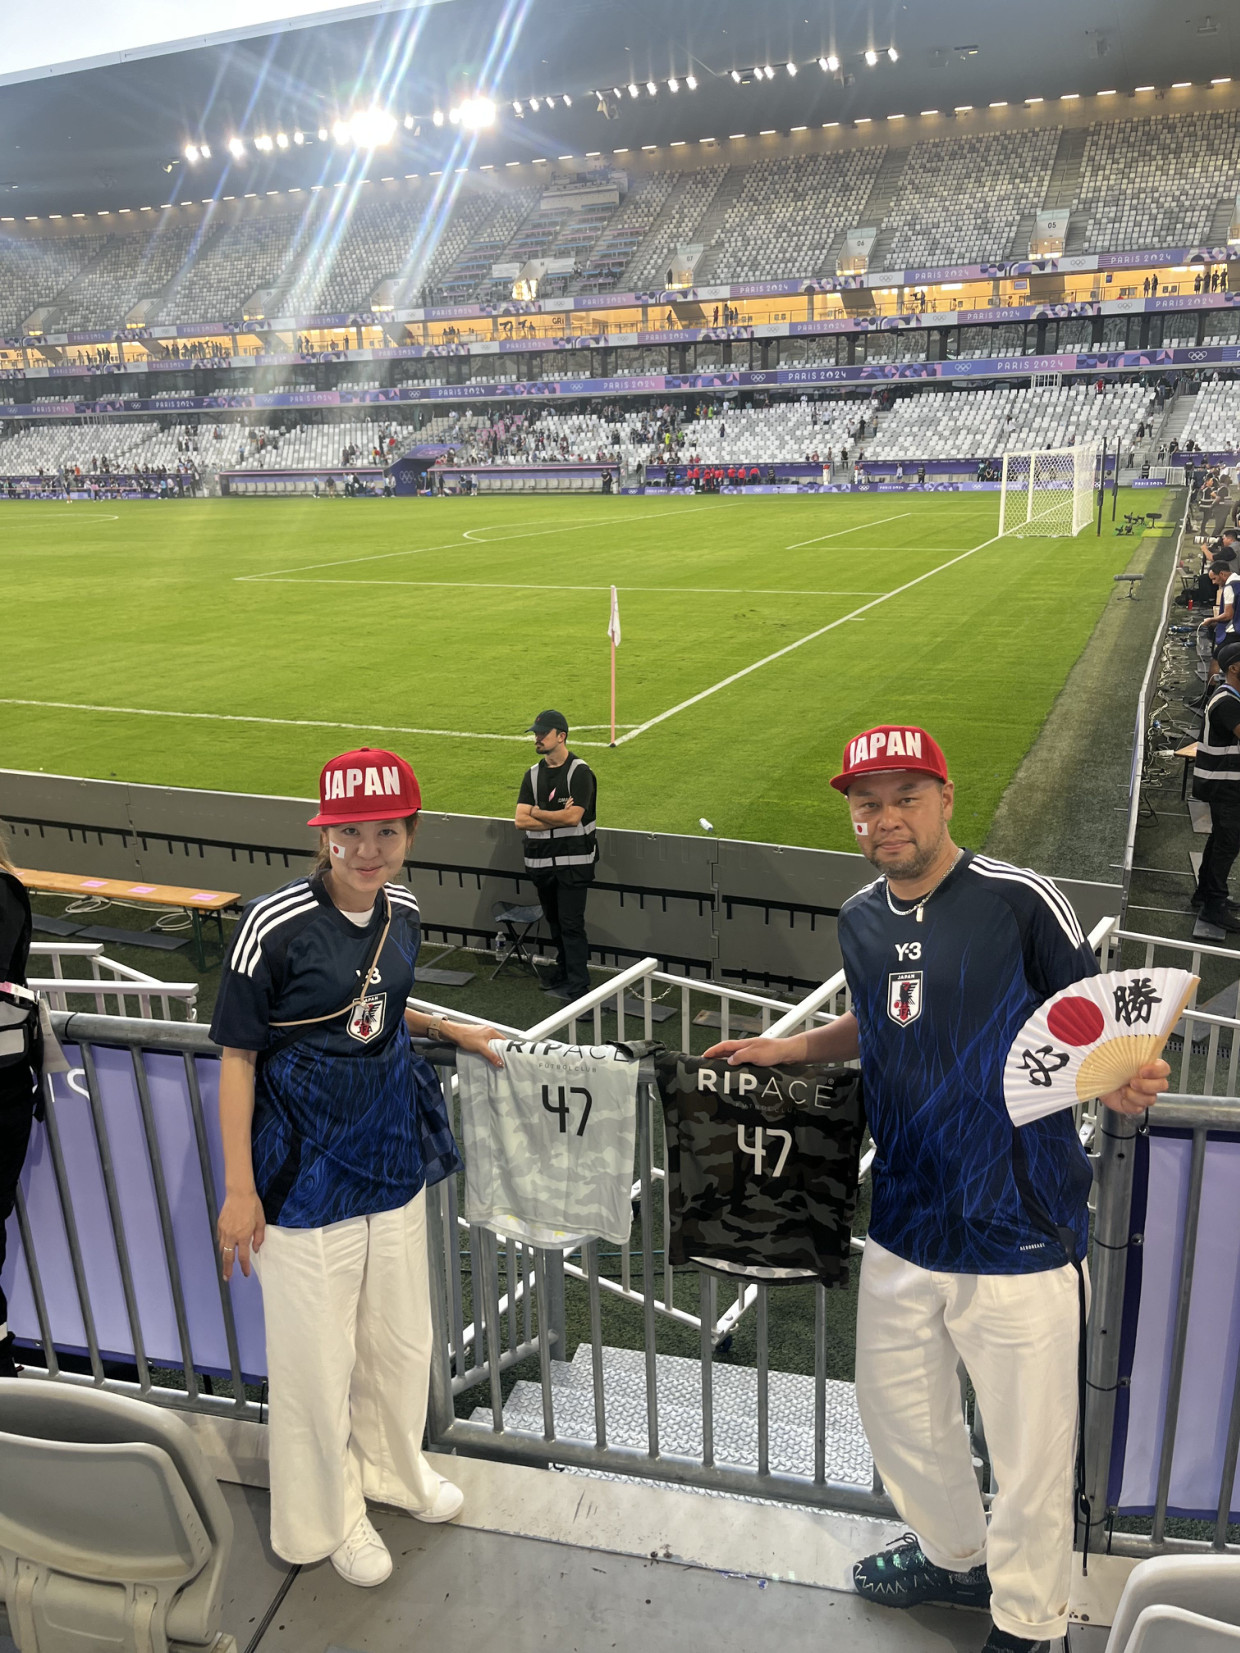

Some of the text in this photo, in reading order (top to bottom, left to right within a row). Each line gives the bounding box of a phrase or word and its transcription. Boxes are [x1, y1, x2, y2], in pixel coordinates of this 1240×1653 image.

[1111, 256, 1140, 264] PARIS
[820, 370, 846, 379] 2024
[998, 361, 1029, 370] PARIS
[850, 731, 922, 769] JAPAN
[325, 766, 400, 800] JAPAN
[1112, 977, 1162, 1027] 勝
[542, 1085, 592, 1136] 47
[737, 1124, 792, 1177] 47
